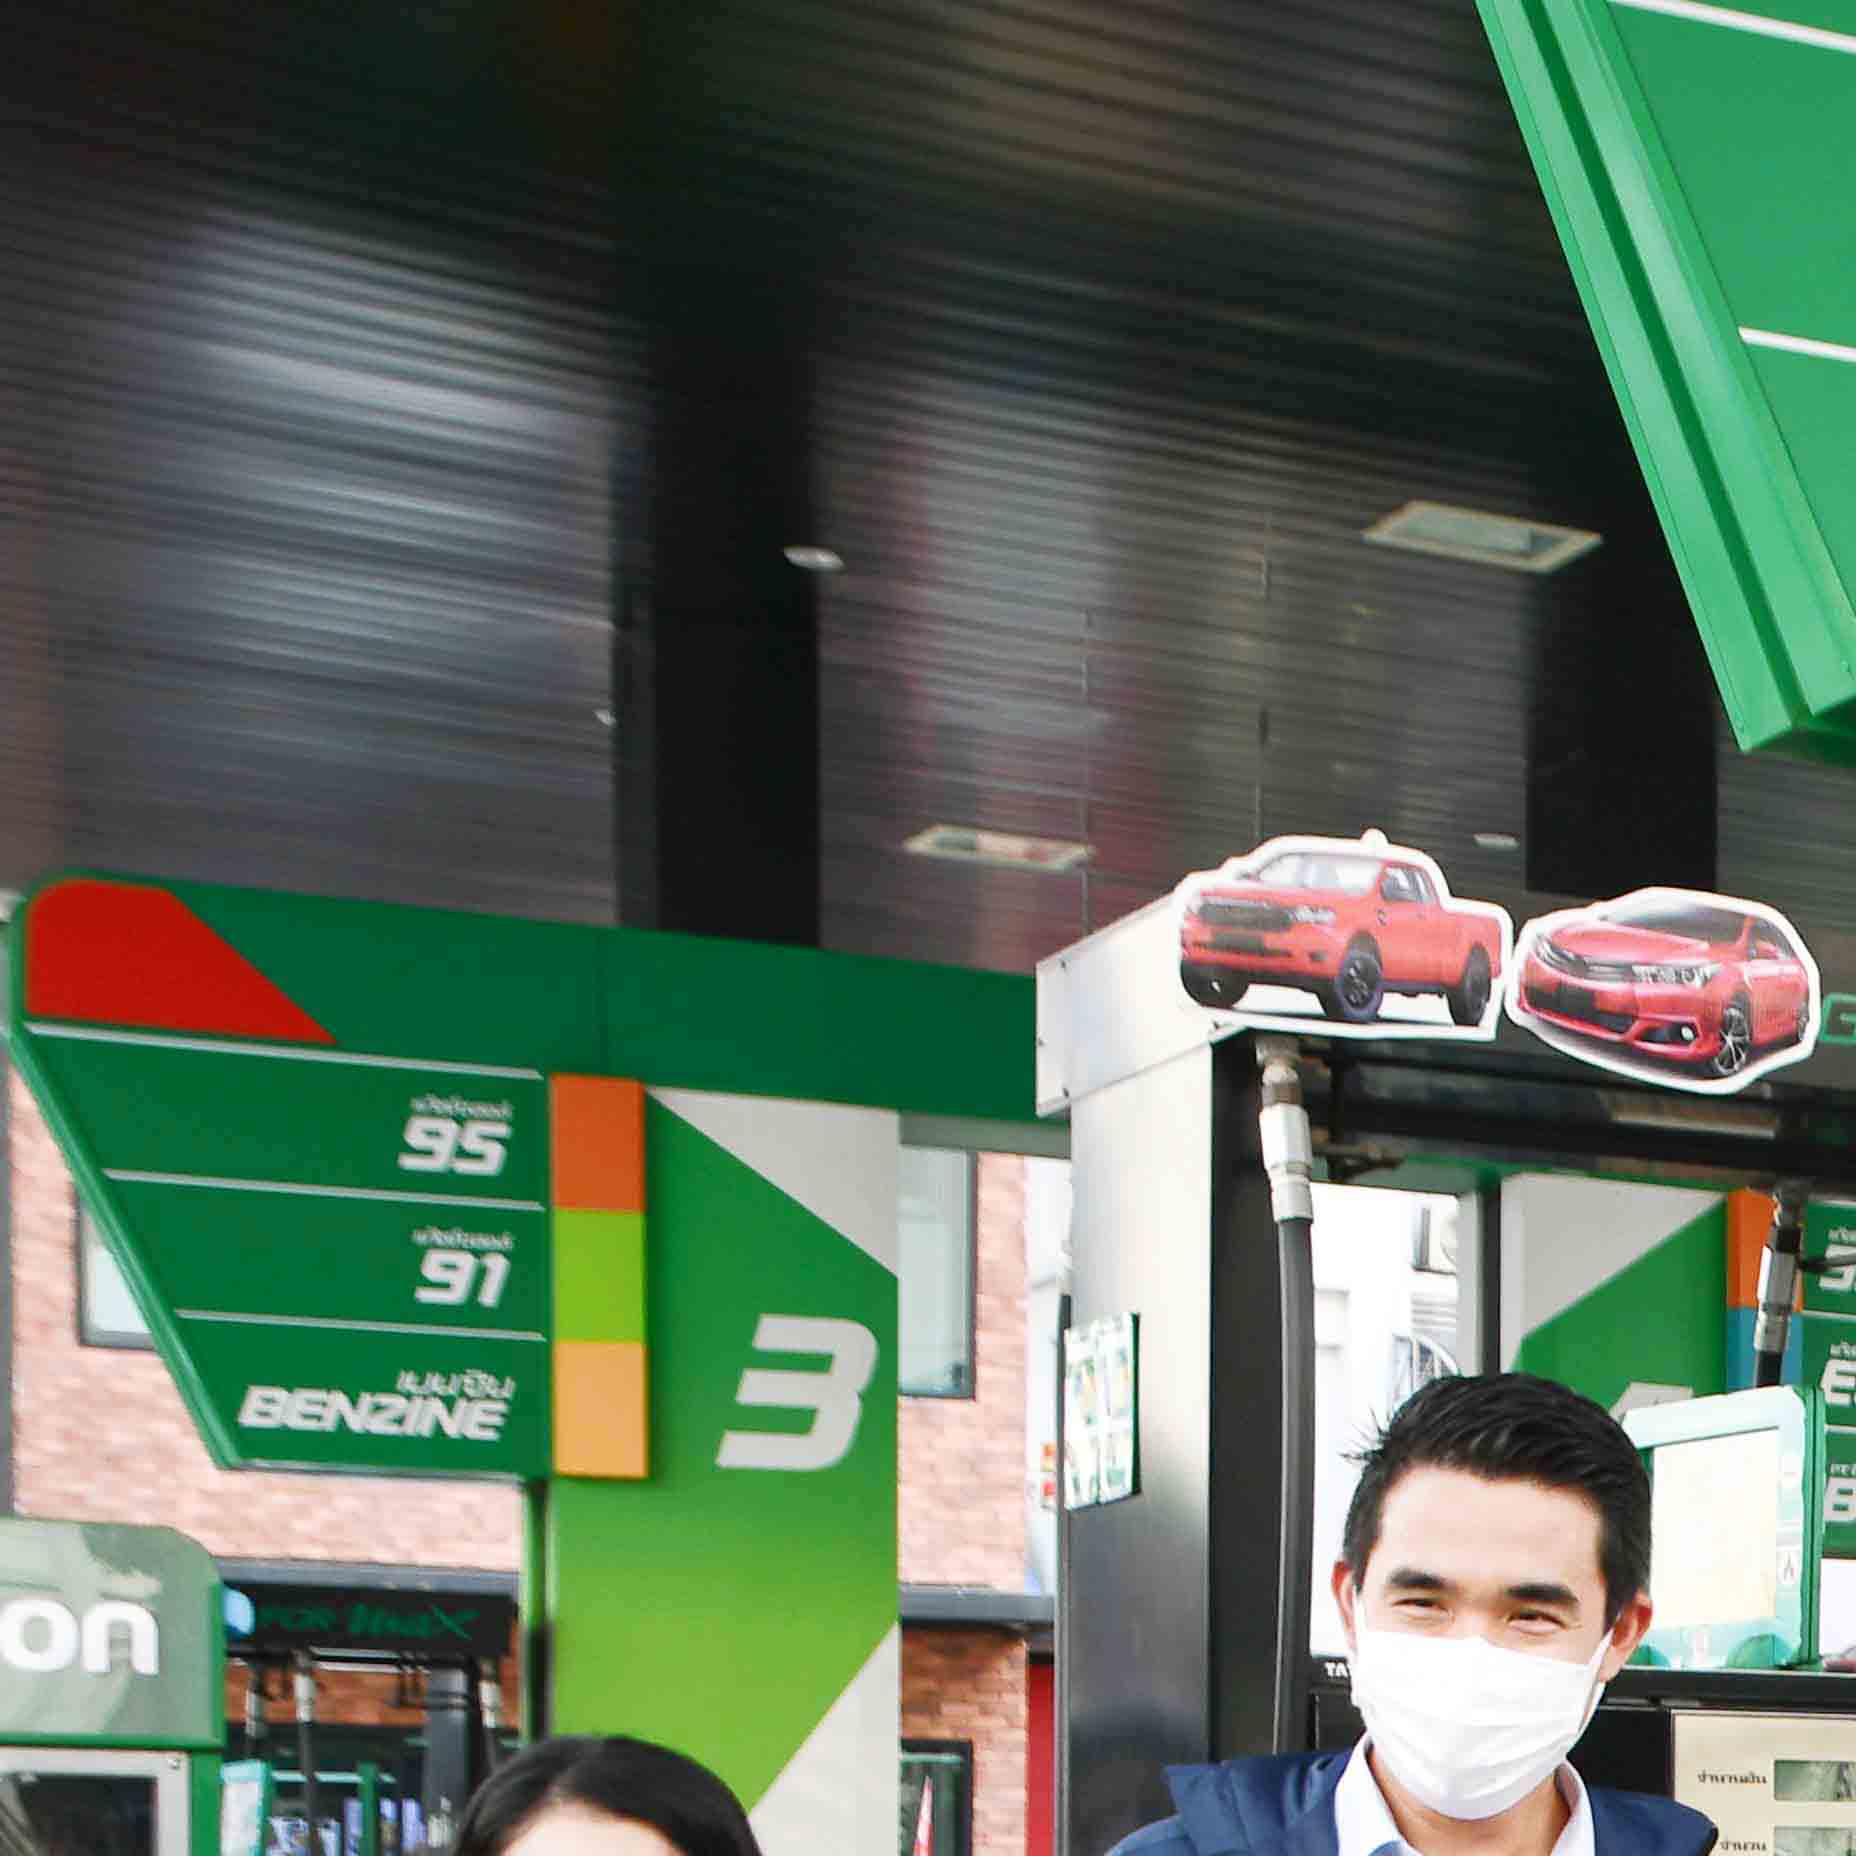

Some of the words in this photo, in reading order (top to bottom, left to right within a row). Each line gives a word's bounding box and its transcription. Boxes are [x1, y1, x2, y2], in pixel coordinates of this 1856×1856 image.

[398, 1116, 511, 1176] 95
[414, 1249, 512, 1308] 91
[237, 1384, 510, 1441] BENZINE
[716, 1313, 879, 1471] 3
